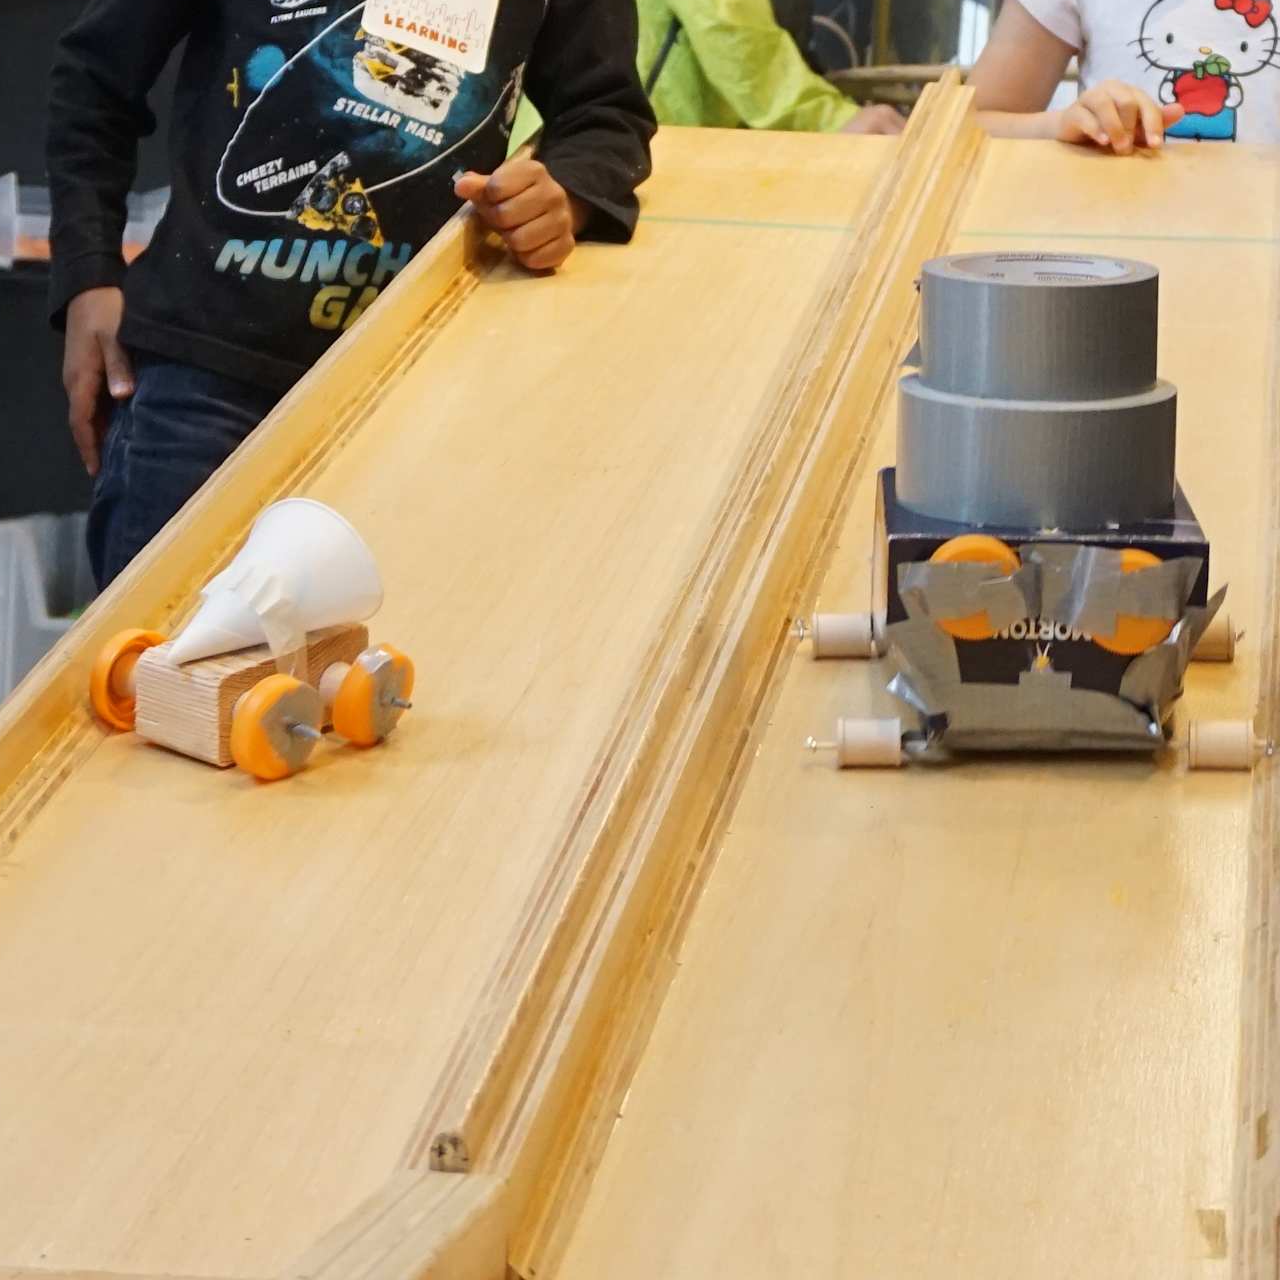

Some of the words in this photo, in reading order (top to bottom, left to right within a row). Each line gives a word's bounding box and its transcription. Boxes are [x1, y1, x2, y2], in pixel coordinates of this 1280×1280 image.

[383, 13, 469, 54] LEARNING
[333, 97, 402, 129] STELLAR
[405, 120, 445, 146] MASS
[236, 157, 284, 187] CHEEZY
[254, 160, 318, 194] TERRAINS
